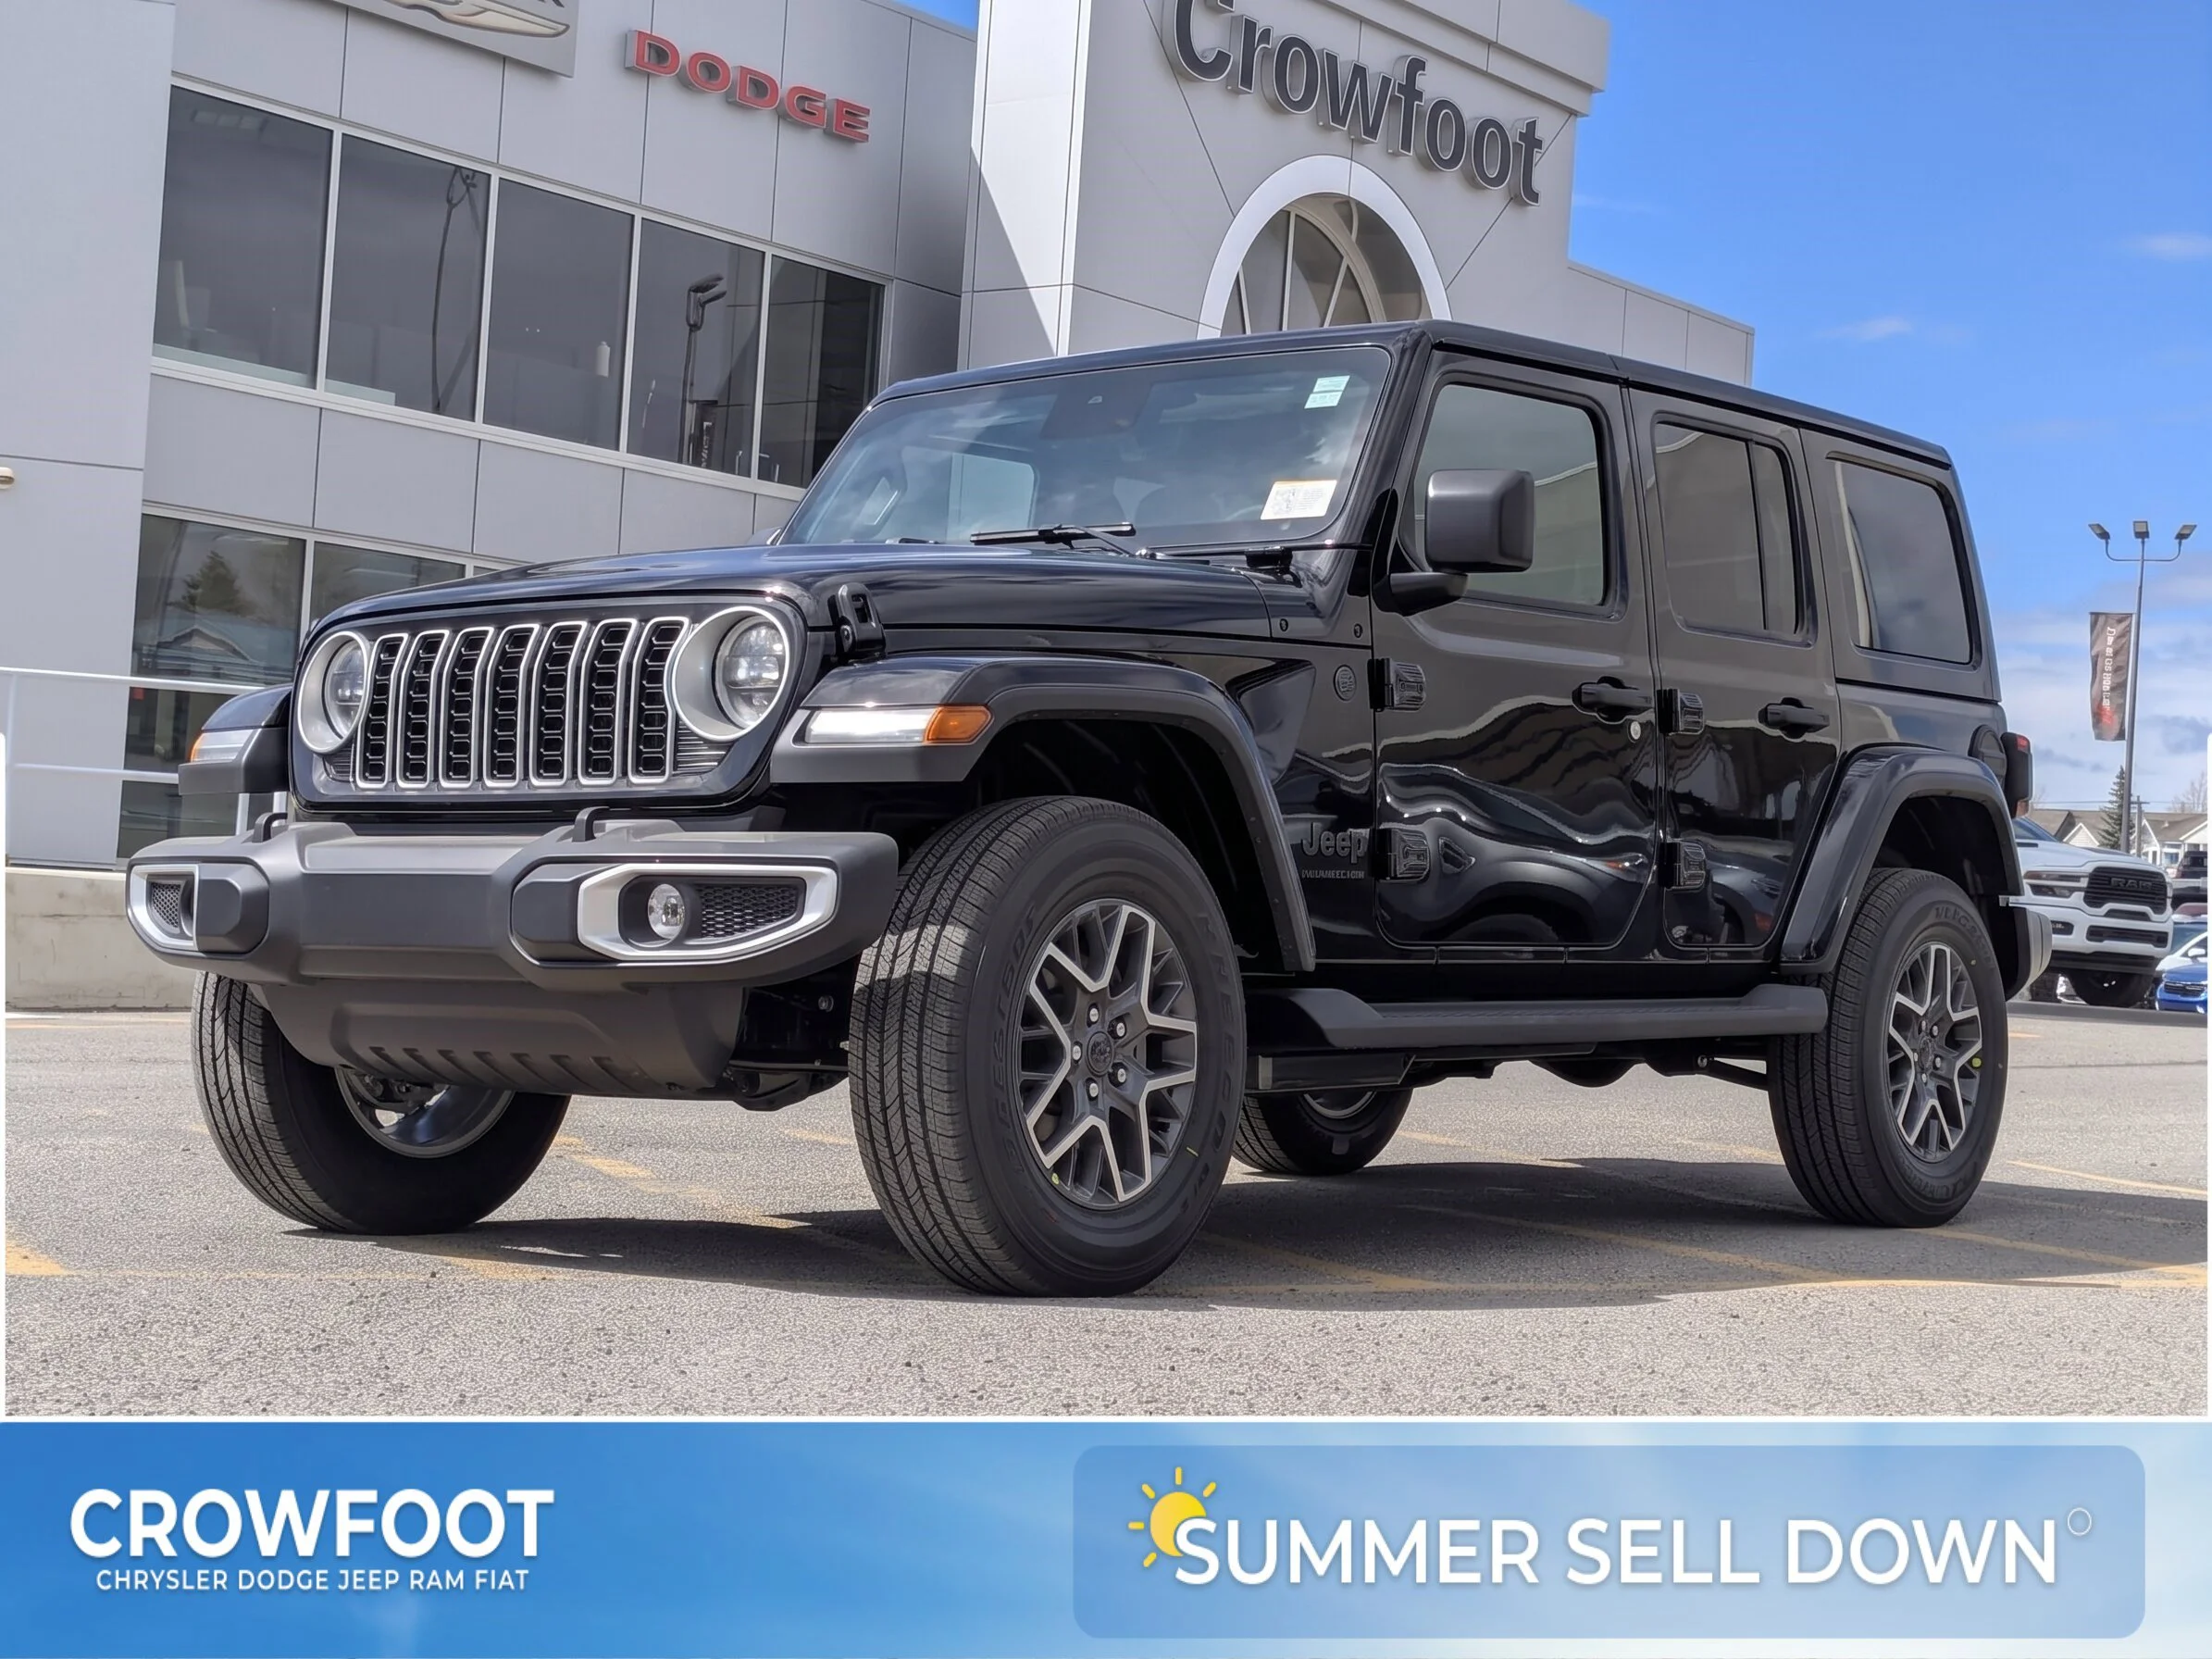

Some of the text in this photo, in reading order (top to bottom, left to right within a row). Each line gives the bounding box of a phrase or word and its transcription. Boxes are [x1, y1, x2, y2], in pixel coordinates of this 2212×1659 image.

[626, 29, 871, 144] DODGE
[1164, 0, 1544, 206] Crowfoot
[1301, 822, 1369, 864] Jeep
